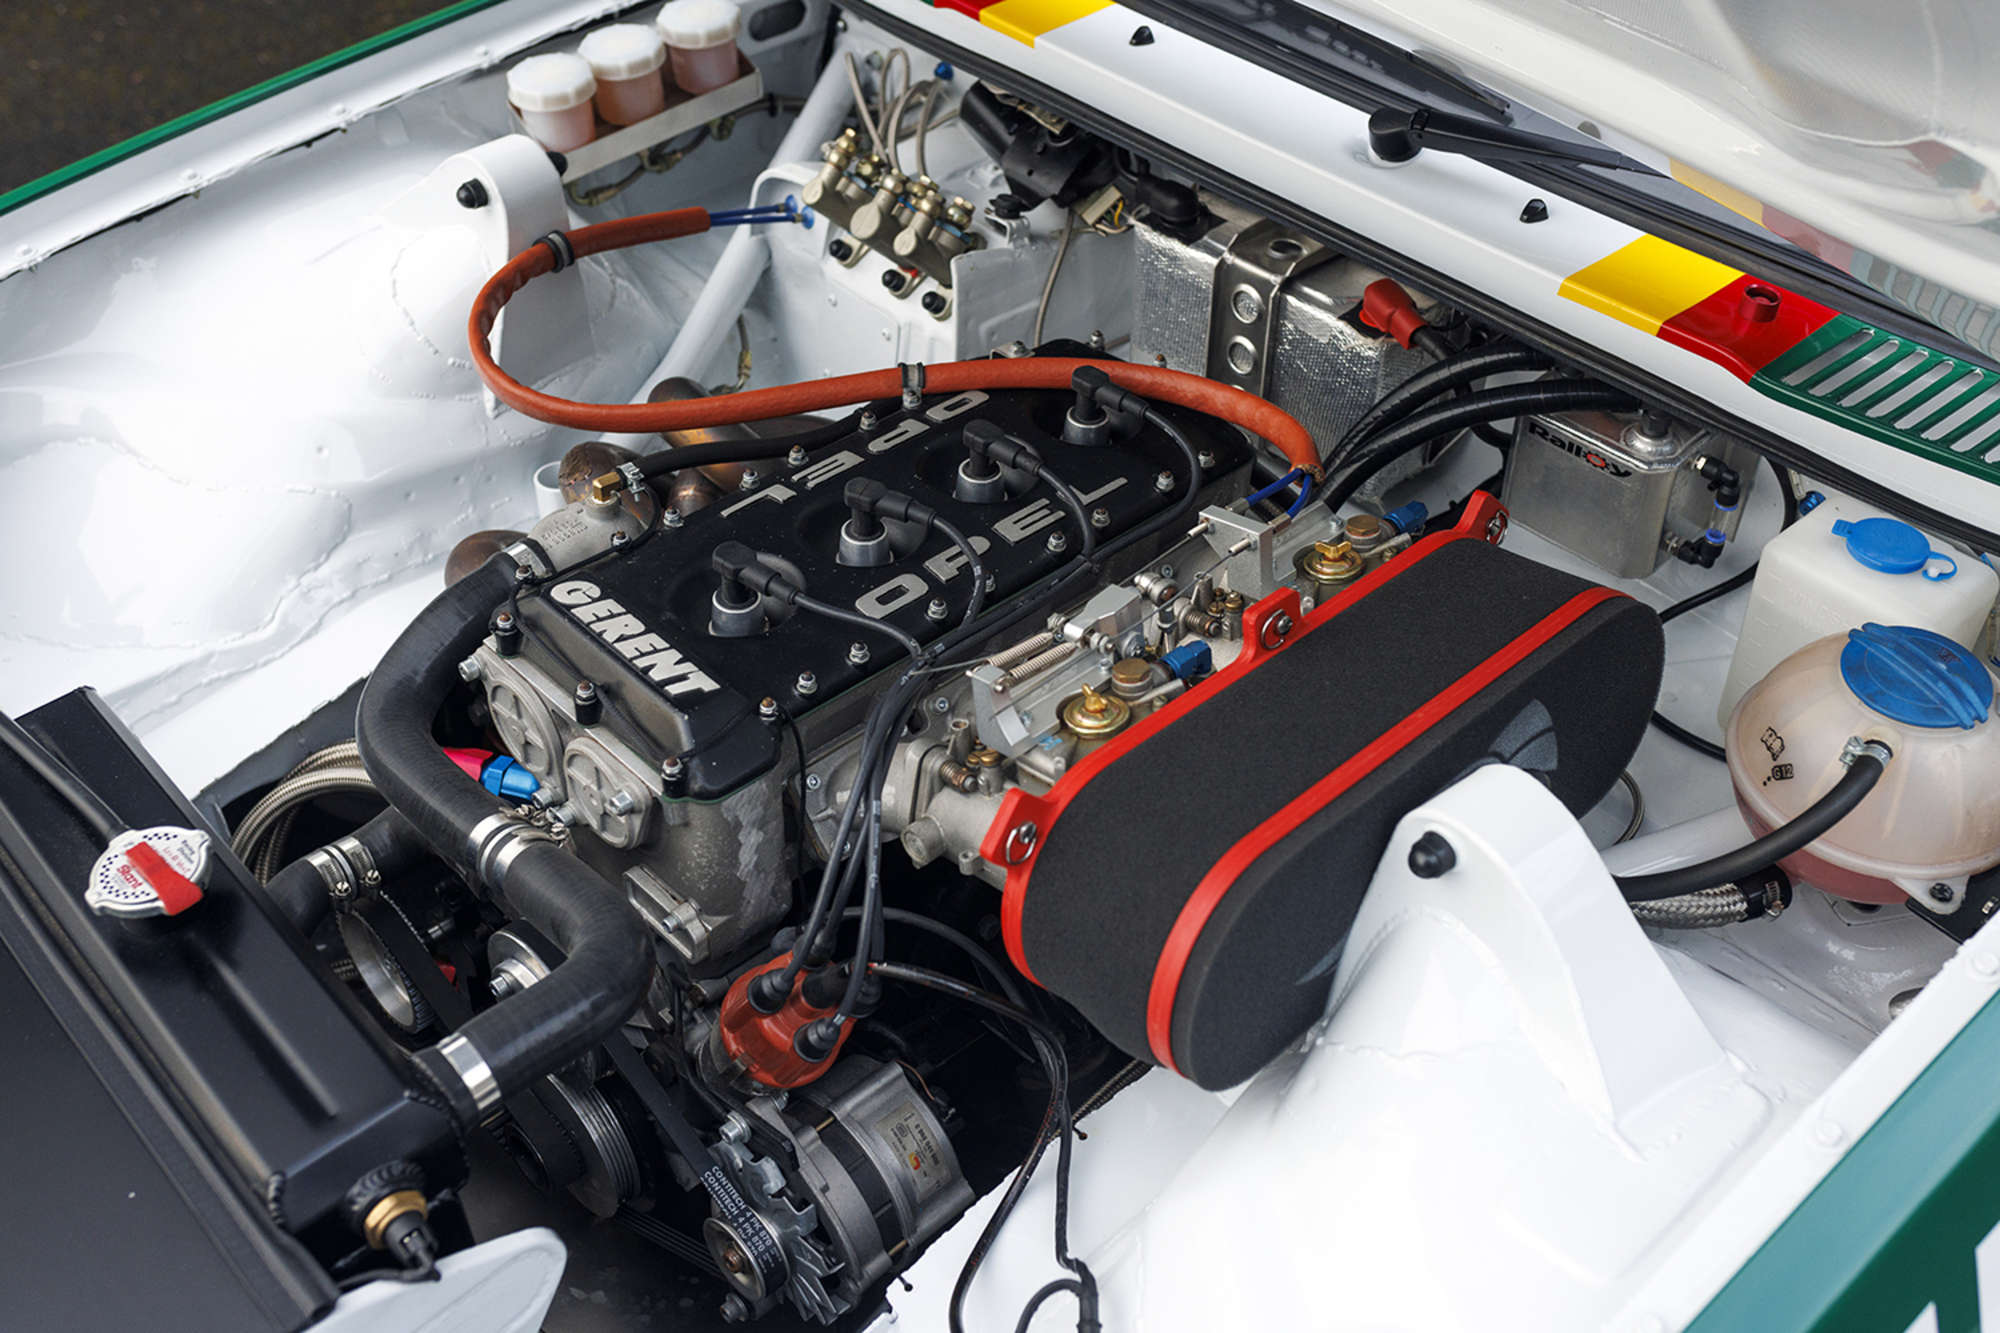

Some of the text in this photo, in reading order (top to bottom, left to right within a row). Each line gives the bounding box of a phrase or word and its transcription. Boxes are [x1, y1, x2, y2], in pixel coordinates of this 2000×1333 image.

[719, 390, 991, 518] OPEL
[855, 476, 1129, 620] OPEL
[550, 580, 721, 696] GERENT
[116, 864, 143, 890] Stant
[704, 1171, 740, 1216] CONTITECH
[742, 1222, 755, 1237] PK
[752, 1236, 766, 1252] 870
[711, 1166, 747, 1210] CONTITECH
[750, 1217, 762, 1231] PK
[760, 1230, 773, 1247] 870
